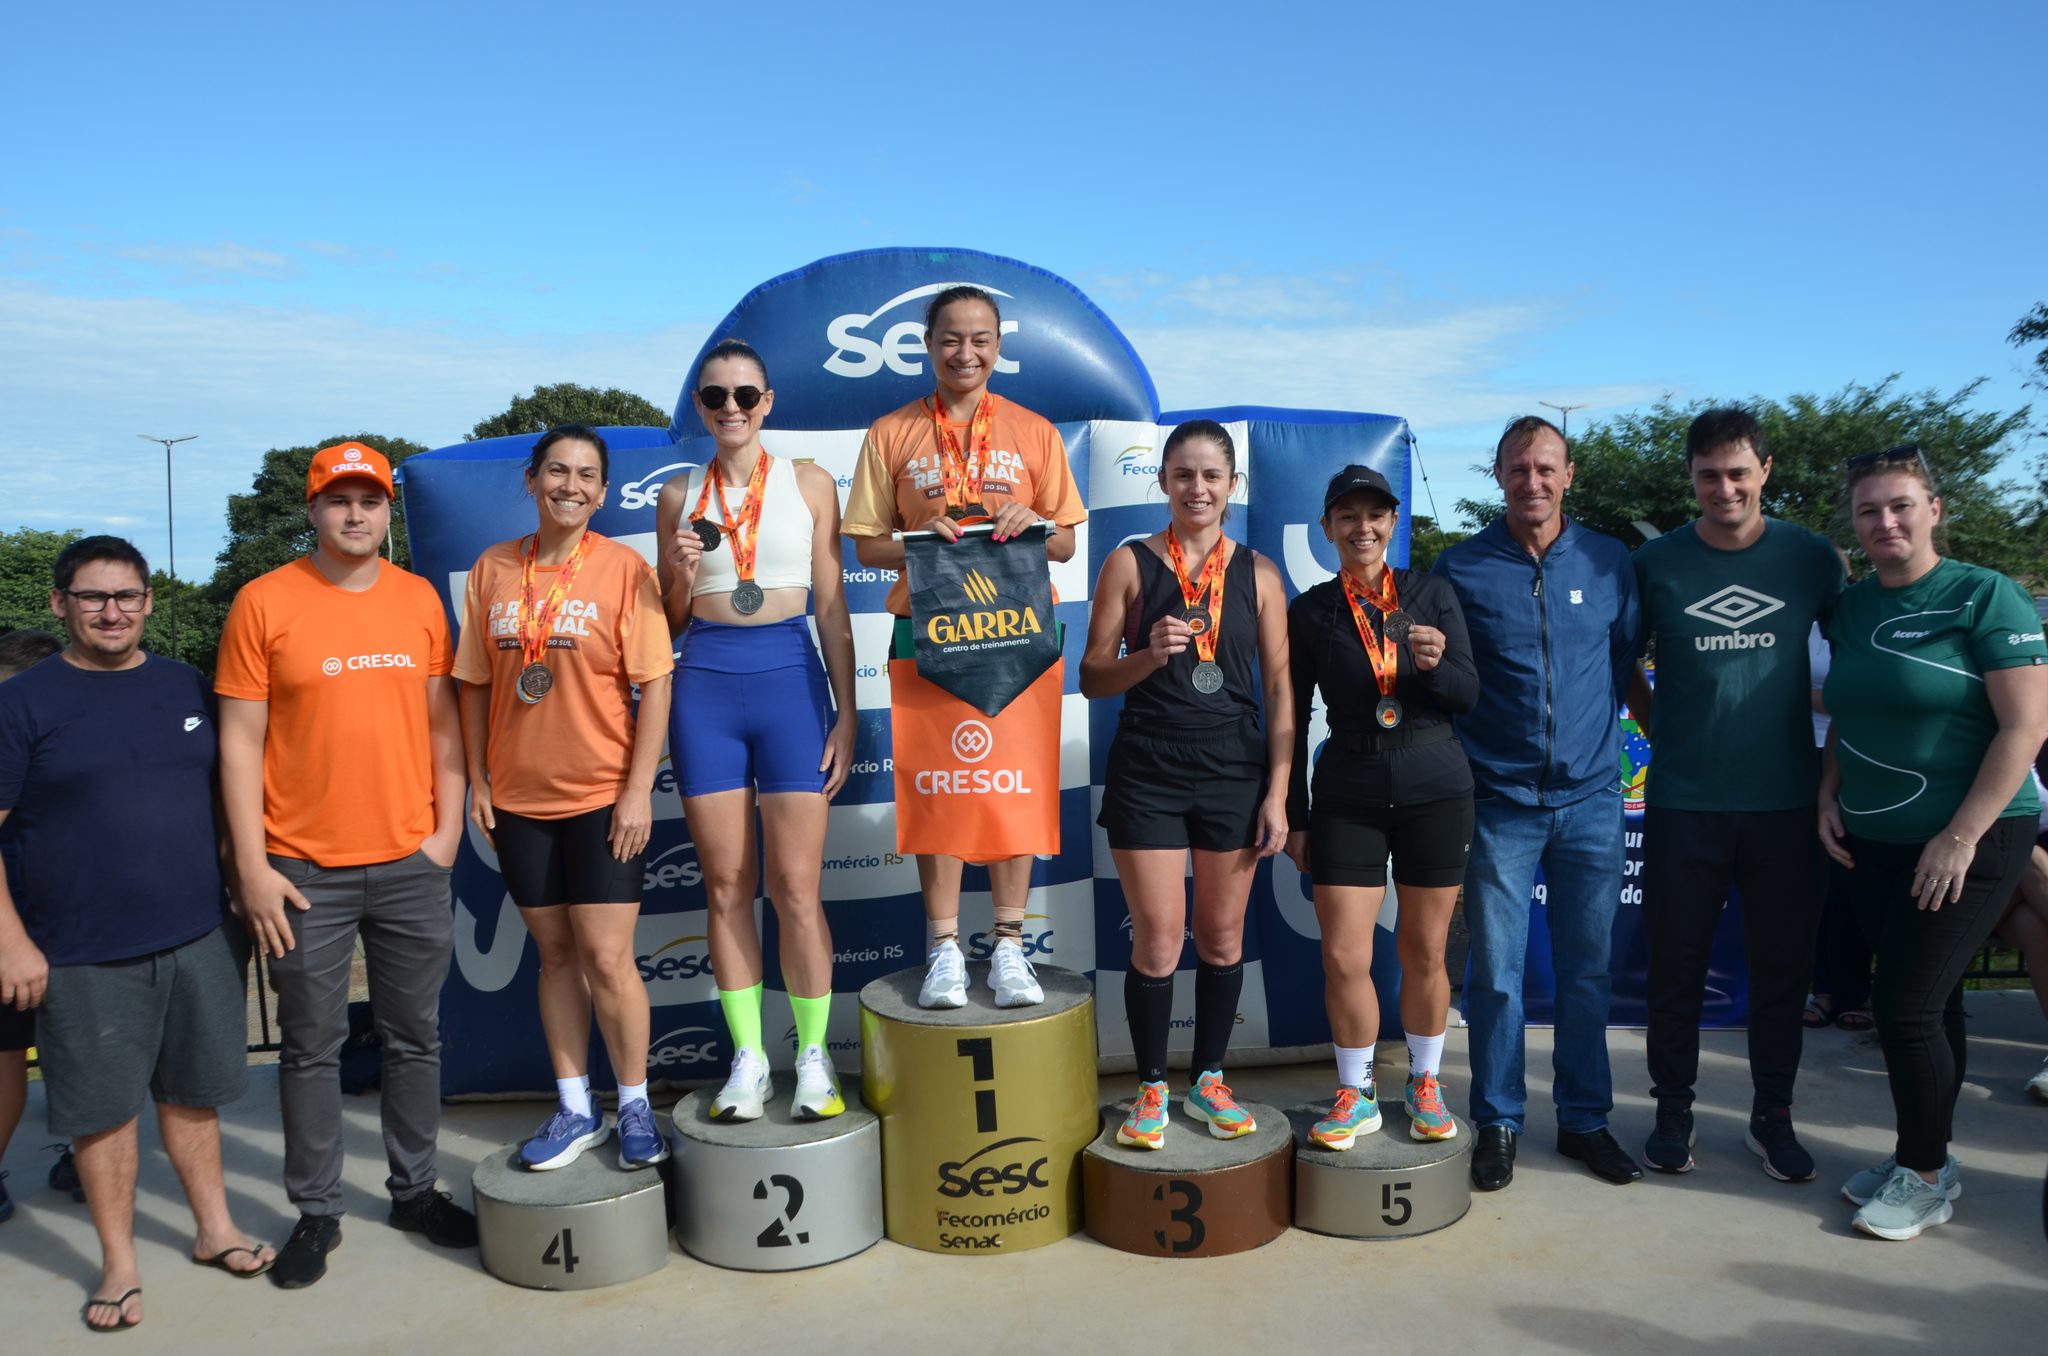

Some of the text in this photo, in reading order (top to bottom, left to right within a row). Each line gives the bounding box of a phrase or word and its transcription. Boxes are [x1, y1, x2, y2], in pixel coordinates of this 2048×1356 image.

[331, 463, 376, 474] CRESOL
[996, 484, 1009, 492] SUL
[881, 569, 900, 582] RS
[927, 606, 1042, 644] GARRA
[943, 645, 969, 653] centro
[981, 638, 1030, 649] treinamento
[1695, 630, 1776, 651] umbro
[347, 653, 417, 670] CRESOL
[915, 769, 1032, 795] CRESOL
[884, 852, 904, 866] RS
[883, 944, 904, 959] RS
[957, 1037, 998, 1133] 1
[753, 1174, 810, 1248] 2
[1381, 1182, 1413, 1226] 5
[937, 1203, 1050, 1228] Fecomércio
[1153, 1179, 1206, 1253] 3
[541, 1228, 579, 1273] 4
[939, 1233, 1001, 1249] Senac
